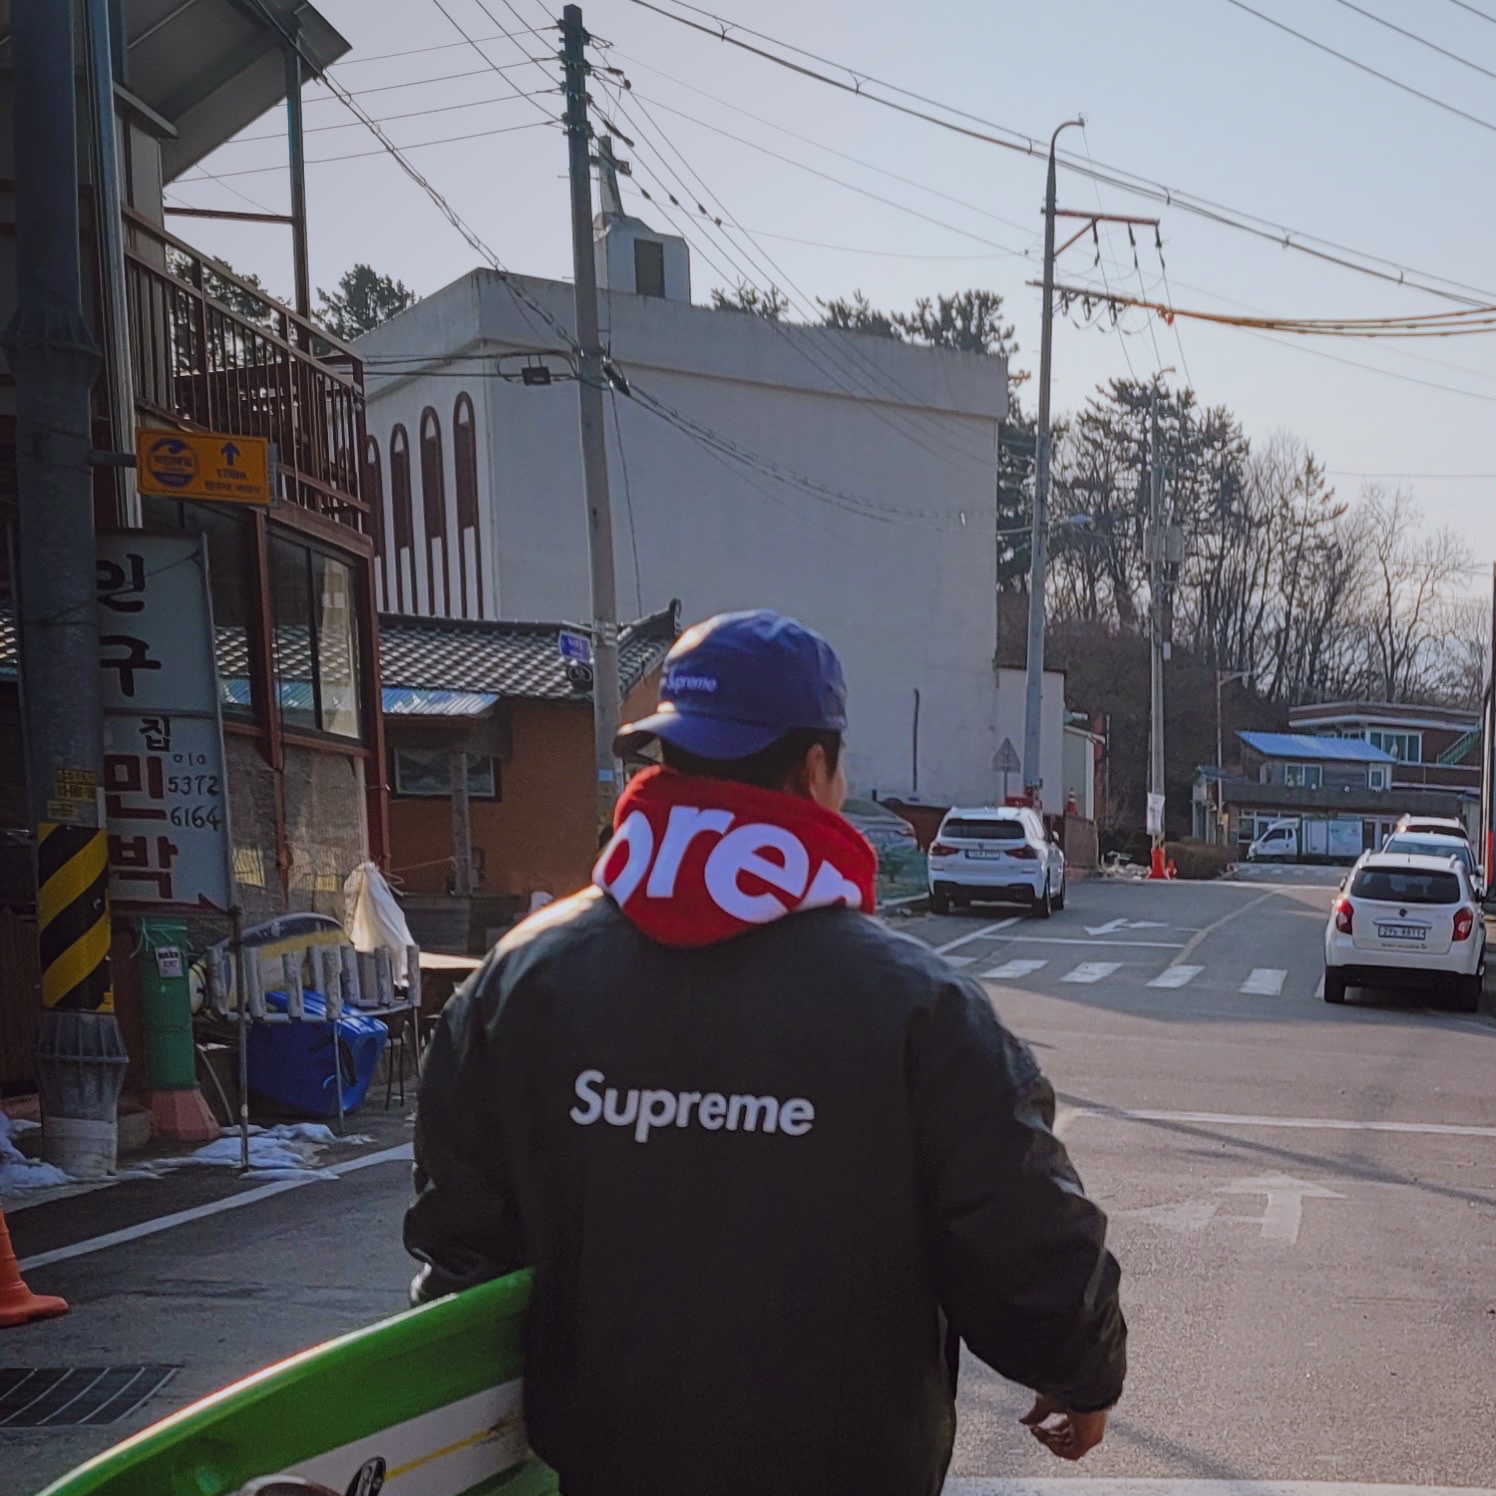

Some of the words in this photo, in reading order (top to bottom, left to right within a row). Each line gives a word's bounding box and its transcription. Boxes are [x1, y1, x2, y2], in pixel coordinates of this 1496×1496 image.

[140, 717, 171, 752] 집
[173, 753, 205, 766] 010
[167, 774, 220, 796] 5372
[104, 754, 179, 899] 민박
[170, 806, 222, 832] 6164
[568, 1068, 817, 1145] Supreme
